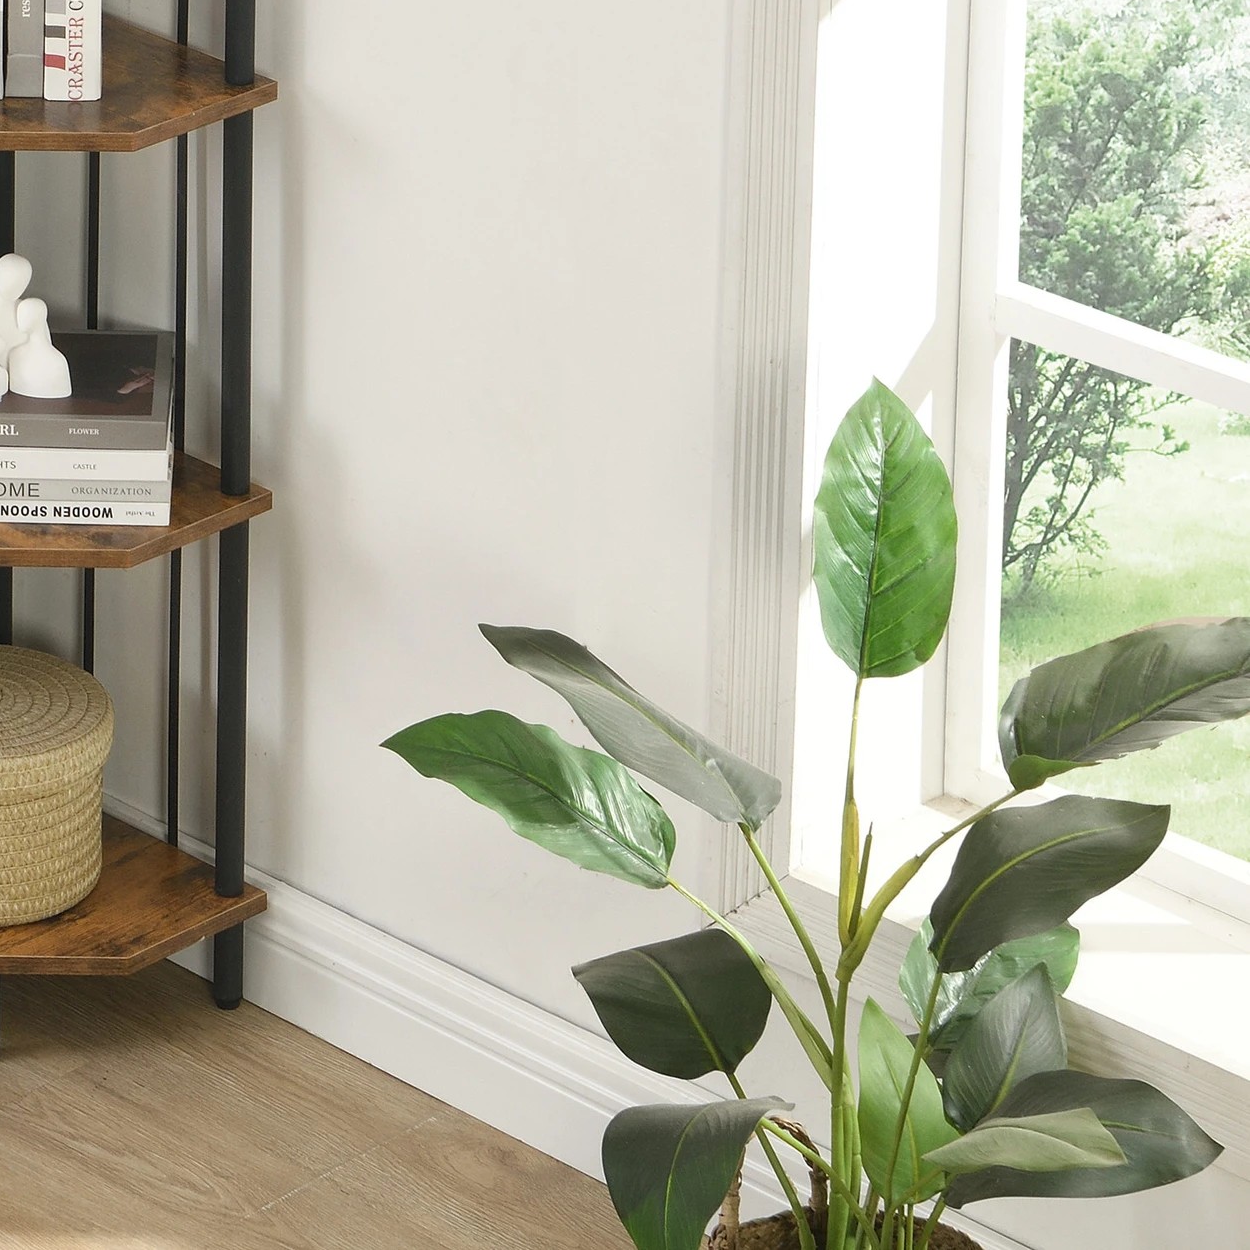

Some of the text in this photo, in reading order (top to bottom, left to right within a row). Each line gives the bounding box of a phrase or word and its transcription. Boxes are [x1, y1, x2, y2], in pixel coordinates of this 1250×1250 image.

[67, 17, 85, 101] CRASTER
[68, 427, 100, 435] FLOWER
[72, 463, 97, 471] CASTLE
[71, 486, 152, 496] ORGANIZATION
[0, 505, 113, 519] WOODEN SPOON
